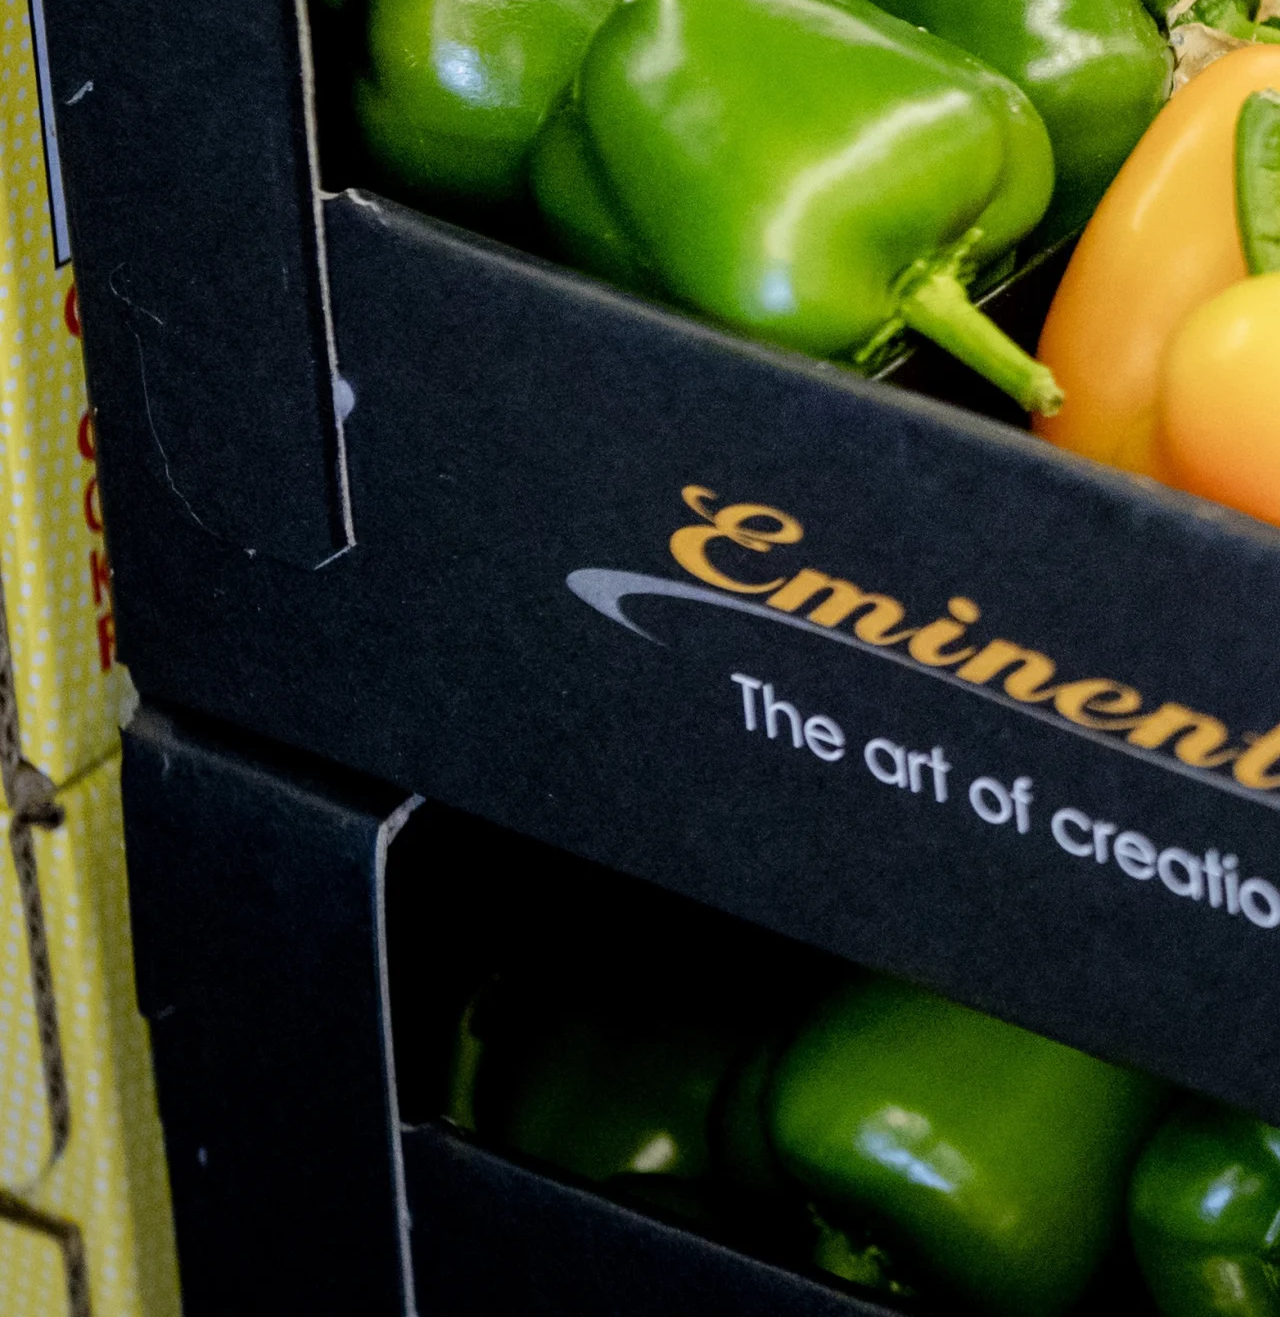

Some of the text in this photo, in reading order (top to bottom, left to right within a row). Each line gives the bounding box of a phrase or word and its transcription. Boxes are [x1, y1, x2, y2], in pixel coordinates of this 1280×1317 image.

[730, 672, 846, 762] The
[863, 736, 950, 804] art
[968, 775, 1035, 834] of
